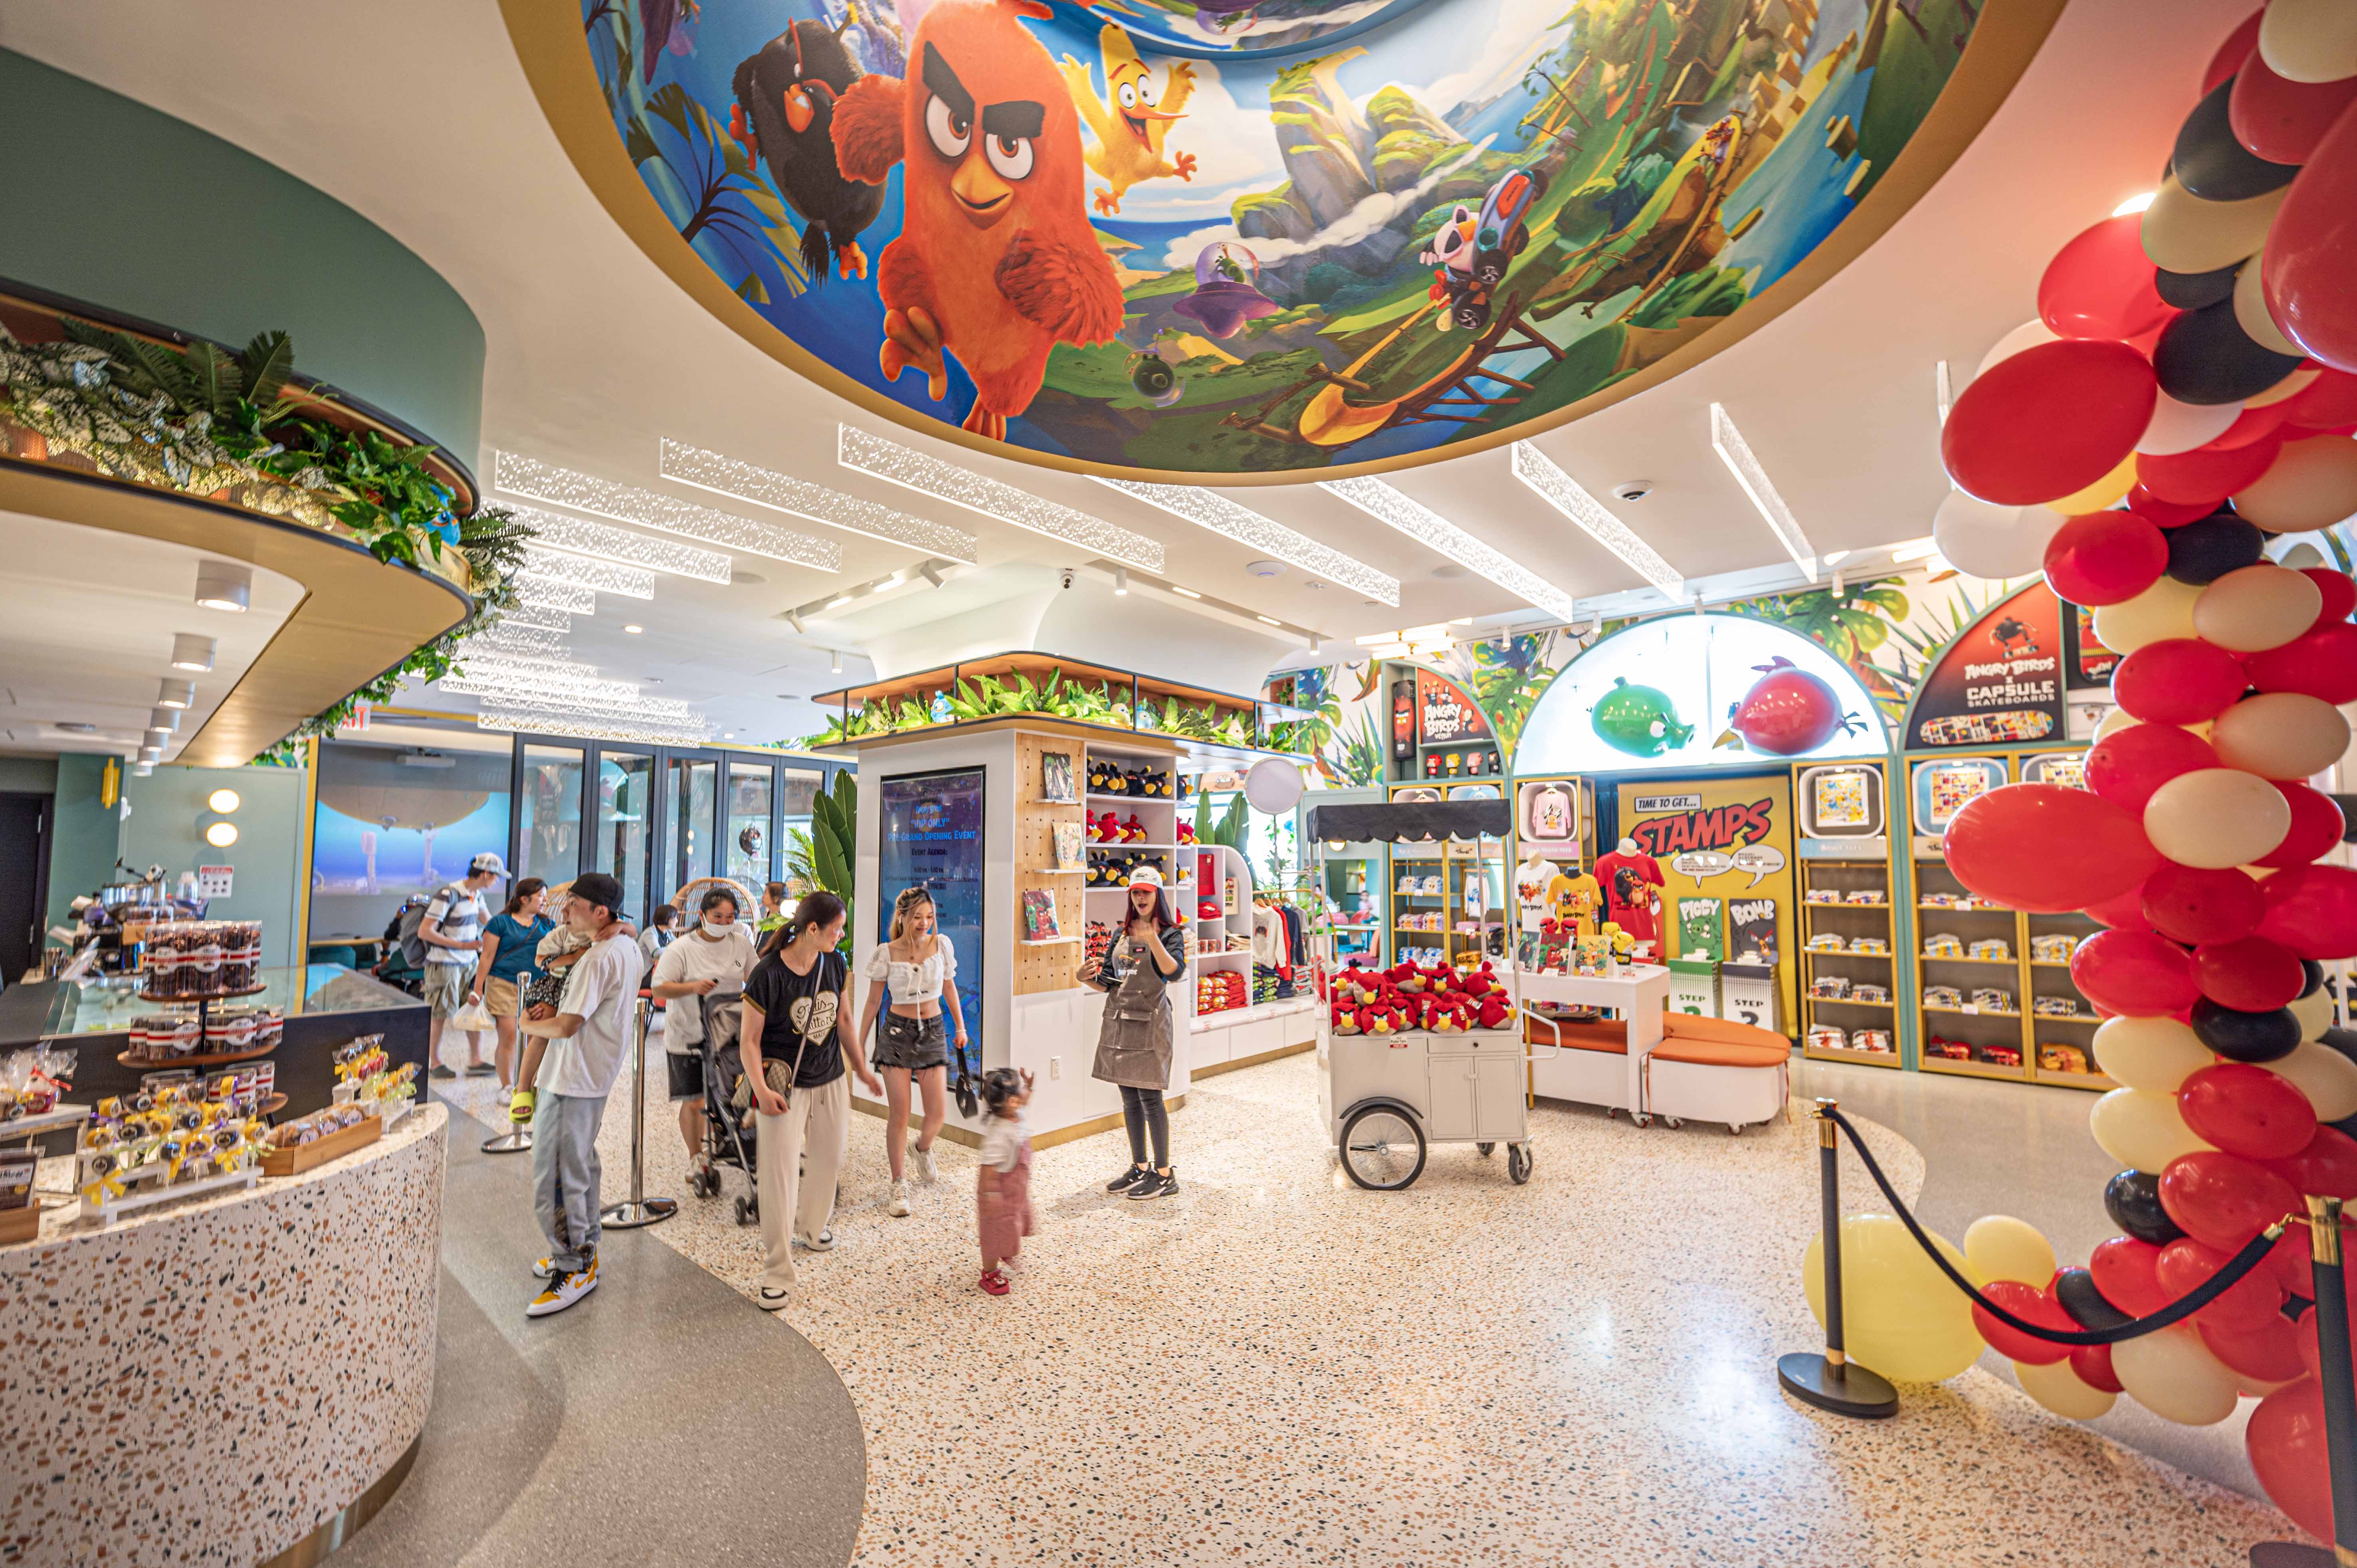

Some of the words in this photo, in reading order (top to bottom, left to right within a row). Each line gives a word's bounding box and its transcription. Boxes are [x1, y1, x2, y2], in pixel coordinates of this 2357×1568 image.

[1965, 662, 2010, 680] ANGRY
[2010, 657, 2055, 675] BIRDS
[1967, 680, 2055, 700] CAPSULE
[1967, 694, 2055, 708] SKATEBOARDS
[1423, 703, 1462, 723] ANGRY
[1424, 718, 1460, 737] BIRDS
[1638, 799, 1658, 809] TIME
[1660, 798, 1670, 808] TO
[1672, 798, 1696, 807] GET...
[910, 819, 927, 829] "VIP
[927, 818, 950, 828] ONLY"
[1630, 797, 1773, 857] STAMPS
[1679, 899, 1720, 921] PIGGY
[1730, 900, 1775, 926] BOMB
[1679, 994, 1705, 1002] STEP
